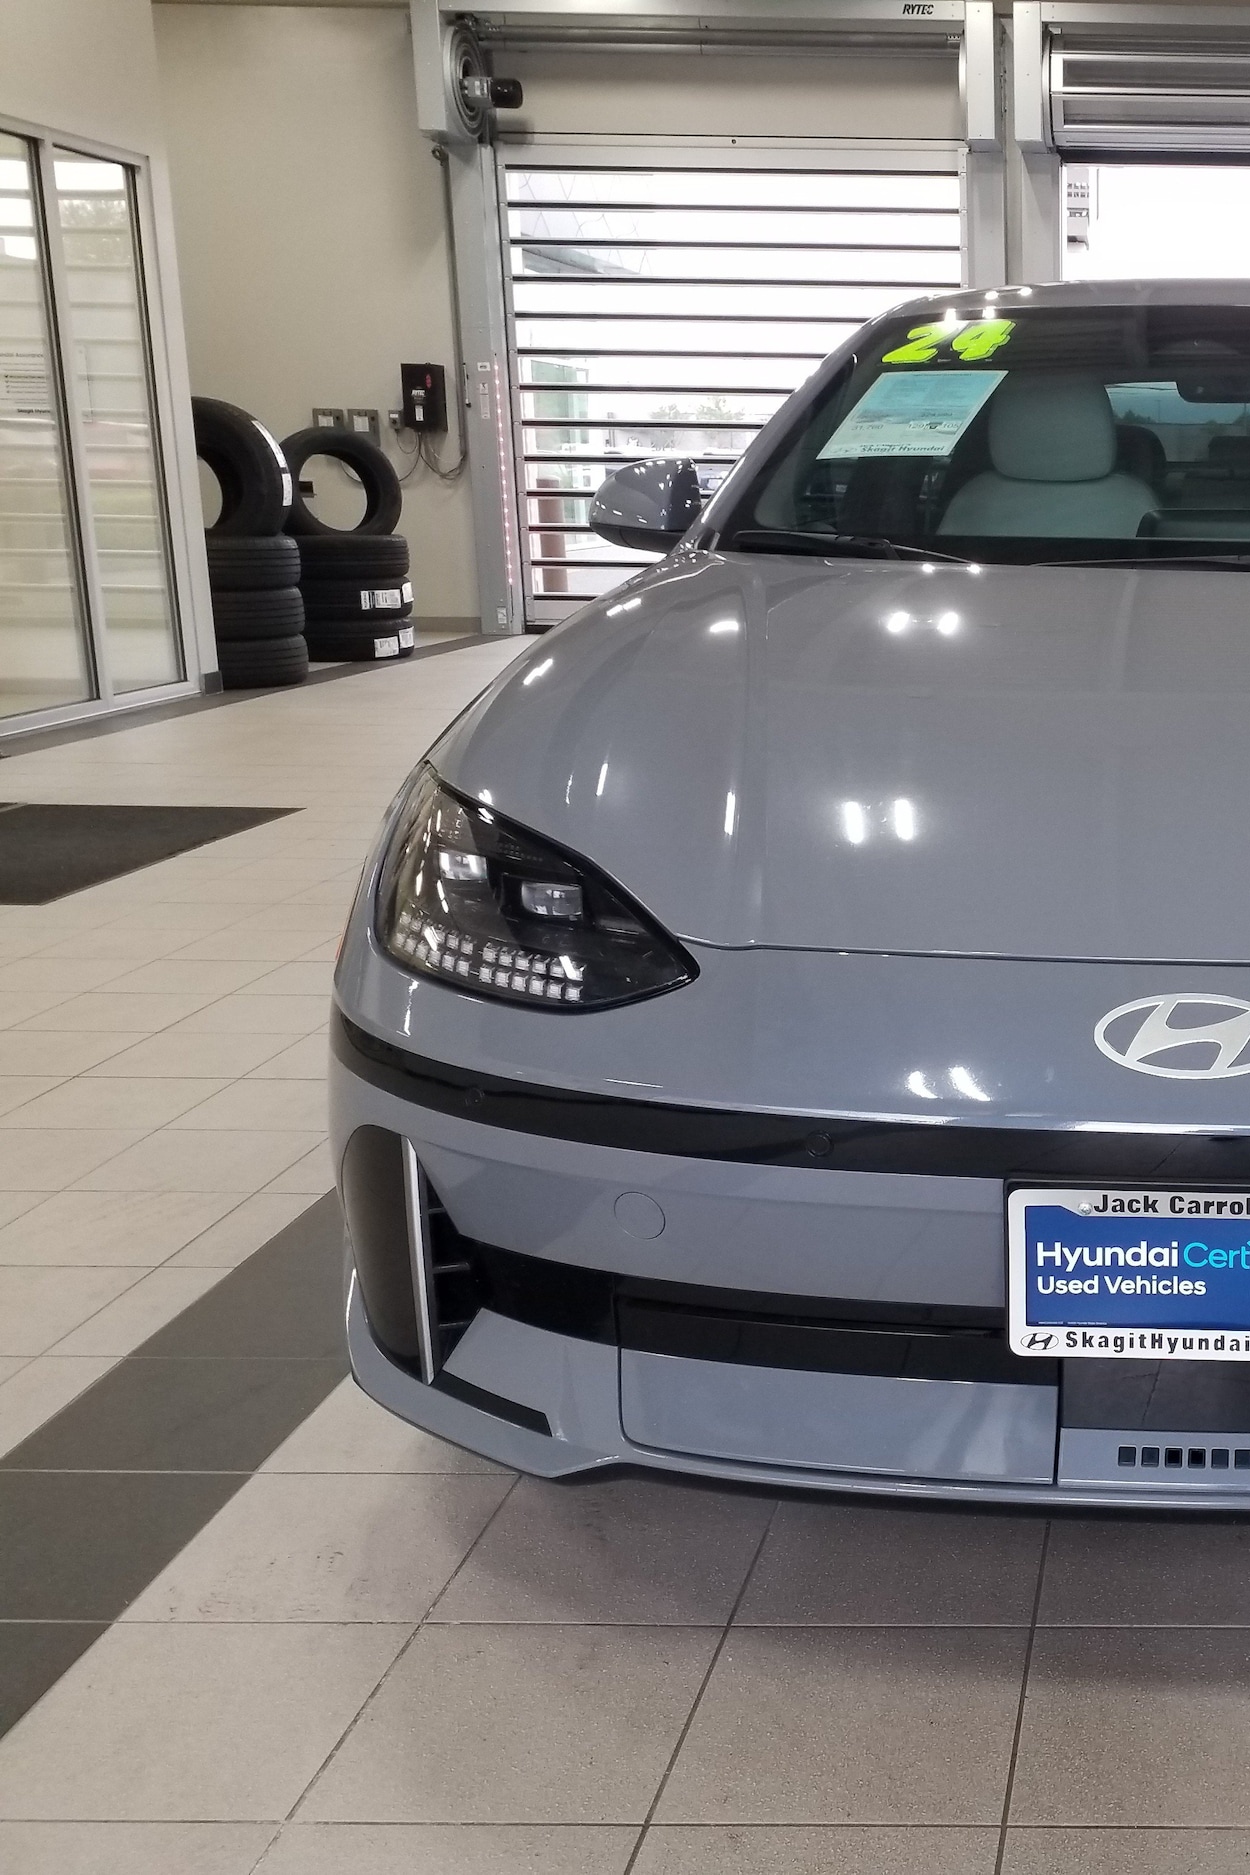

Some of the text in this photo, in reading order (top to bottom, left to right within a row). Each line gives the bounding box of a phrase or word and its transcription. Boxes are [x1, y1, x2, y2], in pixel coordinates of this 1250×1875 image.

[902, 3, 934, 15] RYTEC
[881, 319, 1016, 364] 24
[1093, 1194, 1159, 1214] Jack
[1036, 1241, 1179, 1272] Hyundai
[1036, 1275, 1207, 1296] Used Vehicles
